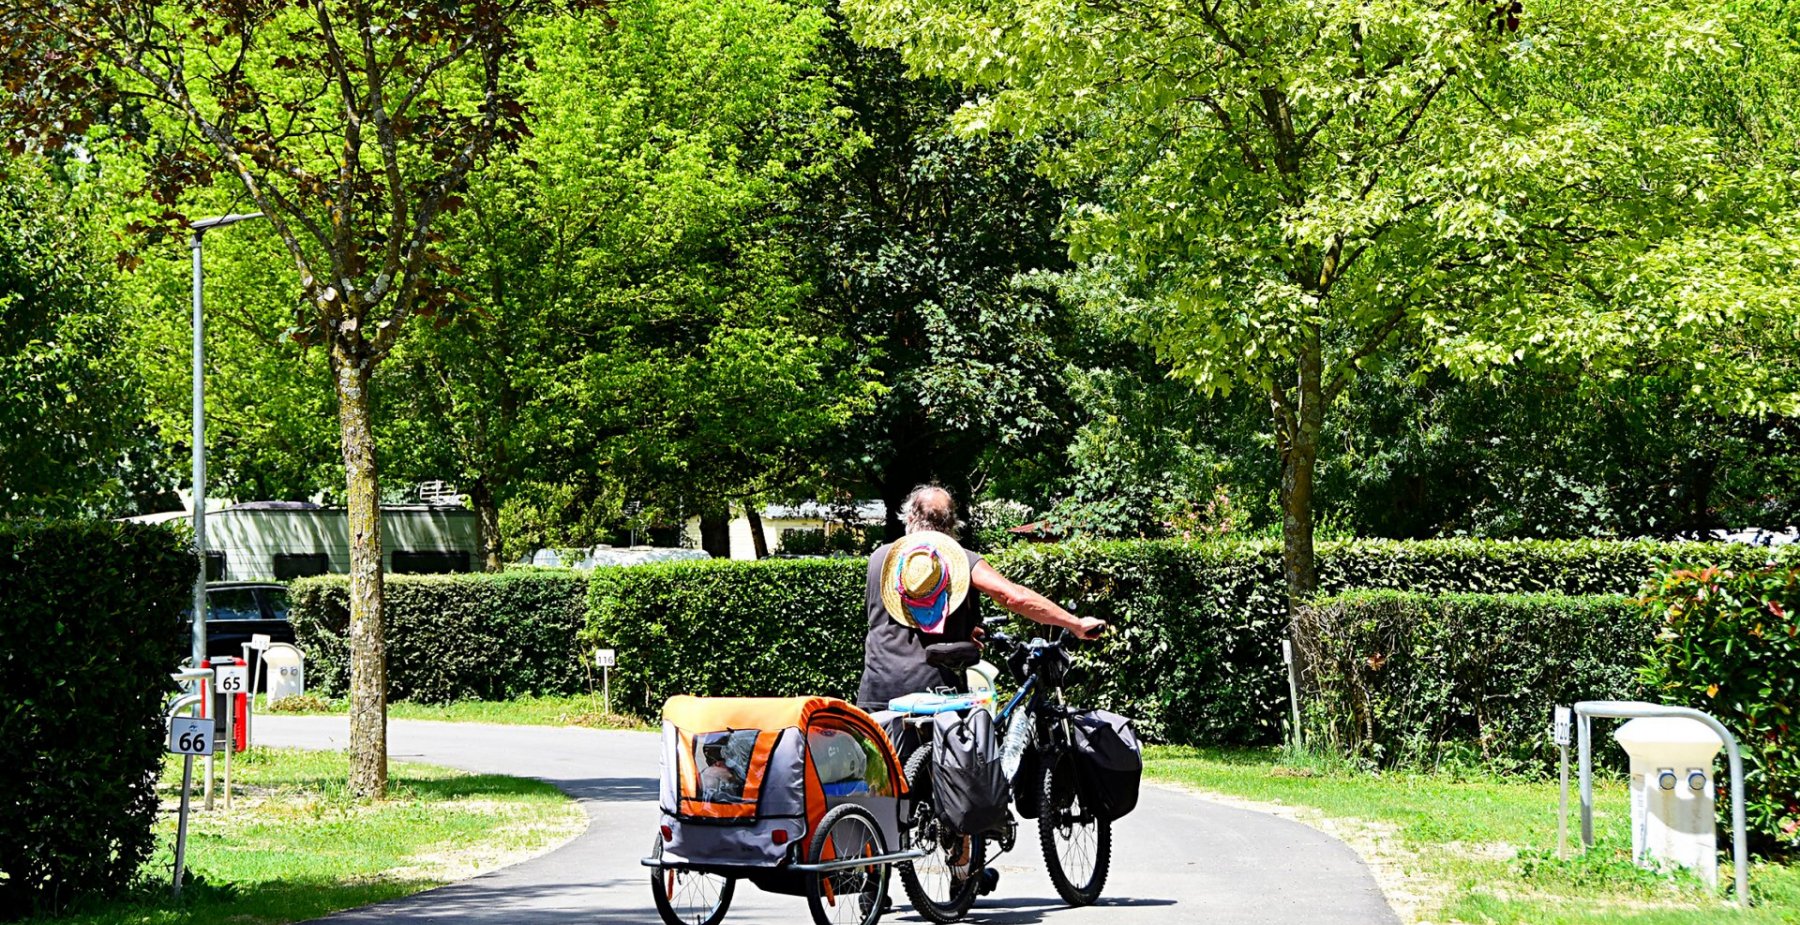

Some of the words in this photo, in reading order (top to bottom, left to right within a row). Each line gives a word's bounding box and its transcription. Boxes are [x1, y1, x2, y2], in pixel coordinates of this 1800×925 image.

[598, 656, 614, 664] 116
[223, 677, 241, 691] 65
[1556, 722, 1568, 740] 120
[179, 732, 205, 752] 66
